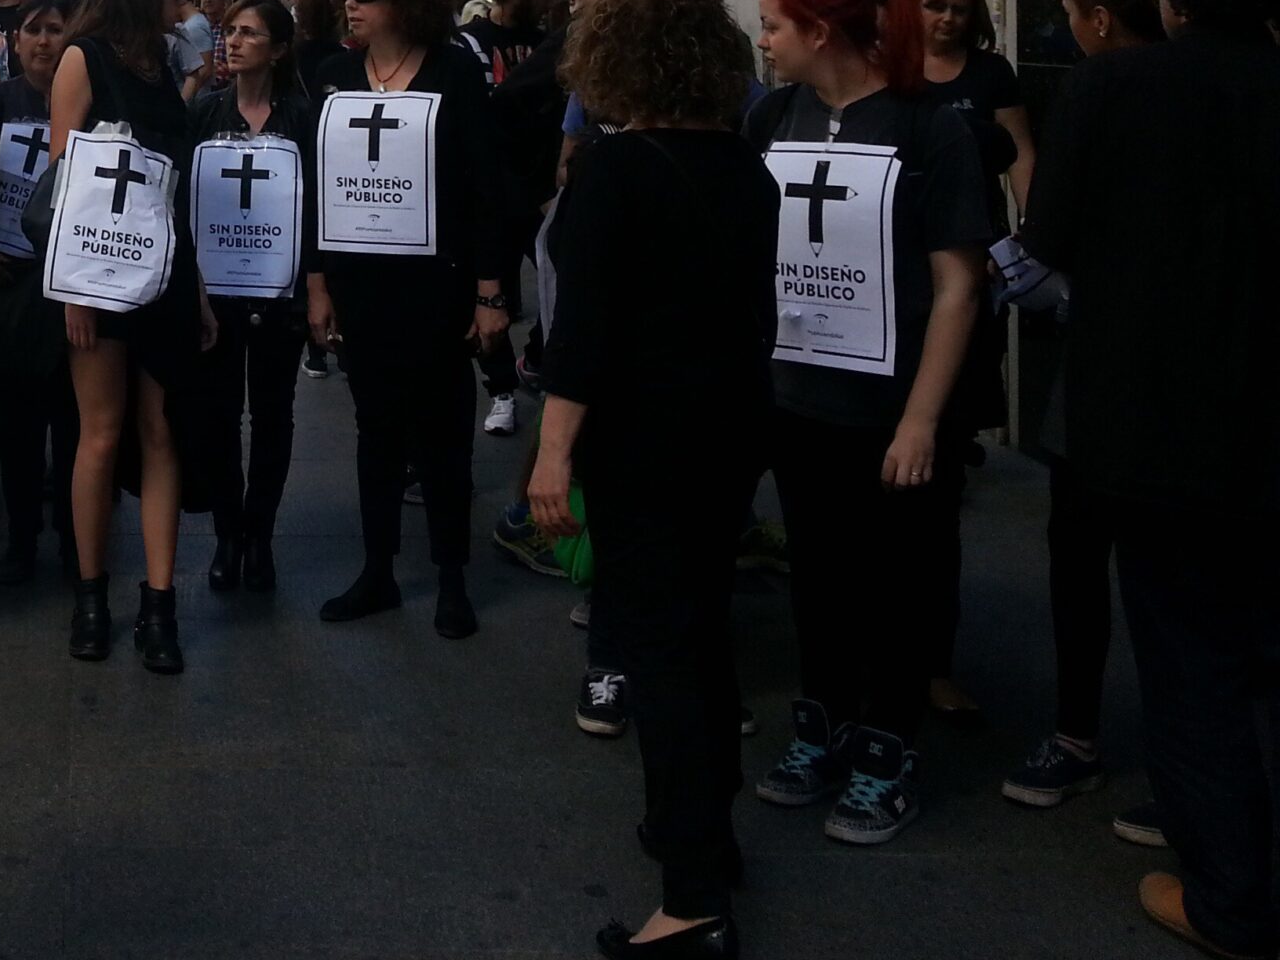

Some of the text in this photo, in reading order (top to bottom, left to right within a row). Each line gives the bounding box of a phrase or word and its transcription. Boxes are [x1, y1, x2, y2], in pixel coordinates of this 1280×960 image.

[336, 176, 413, 191] SIN DISEÑO
[346, 189, 403, 204] PÚBLICO
[73, 224, 154, 249] SIN DISEÑO
[209, 222, 282, 237] SIN DISEÑO
[81, 240, 142, 261] PÚBLICO
[218, 235, 273, 249] PÚBLICO
[803, 264, 866, 284] DISEÑO
[784, 278, 855, 301] PÚBLICO
